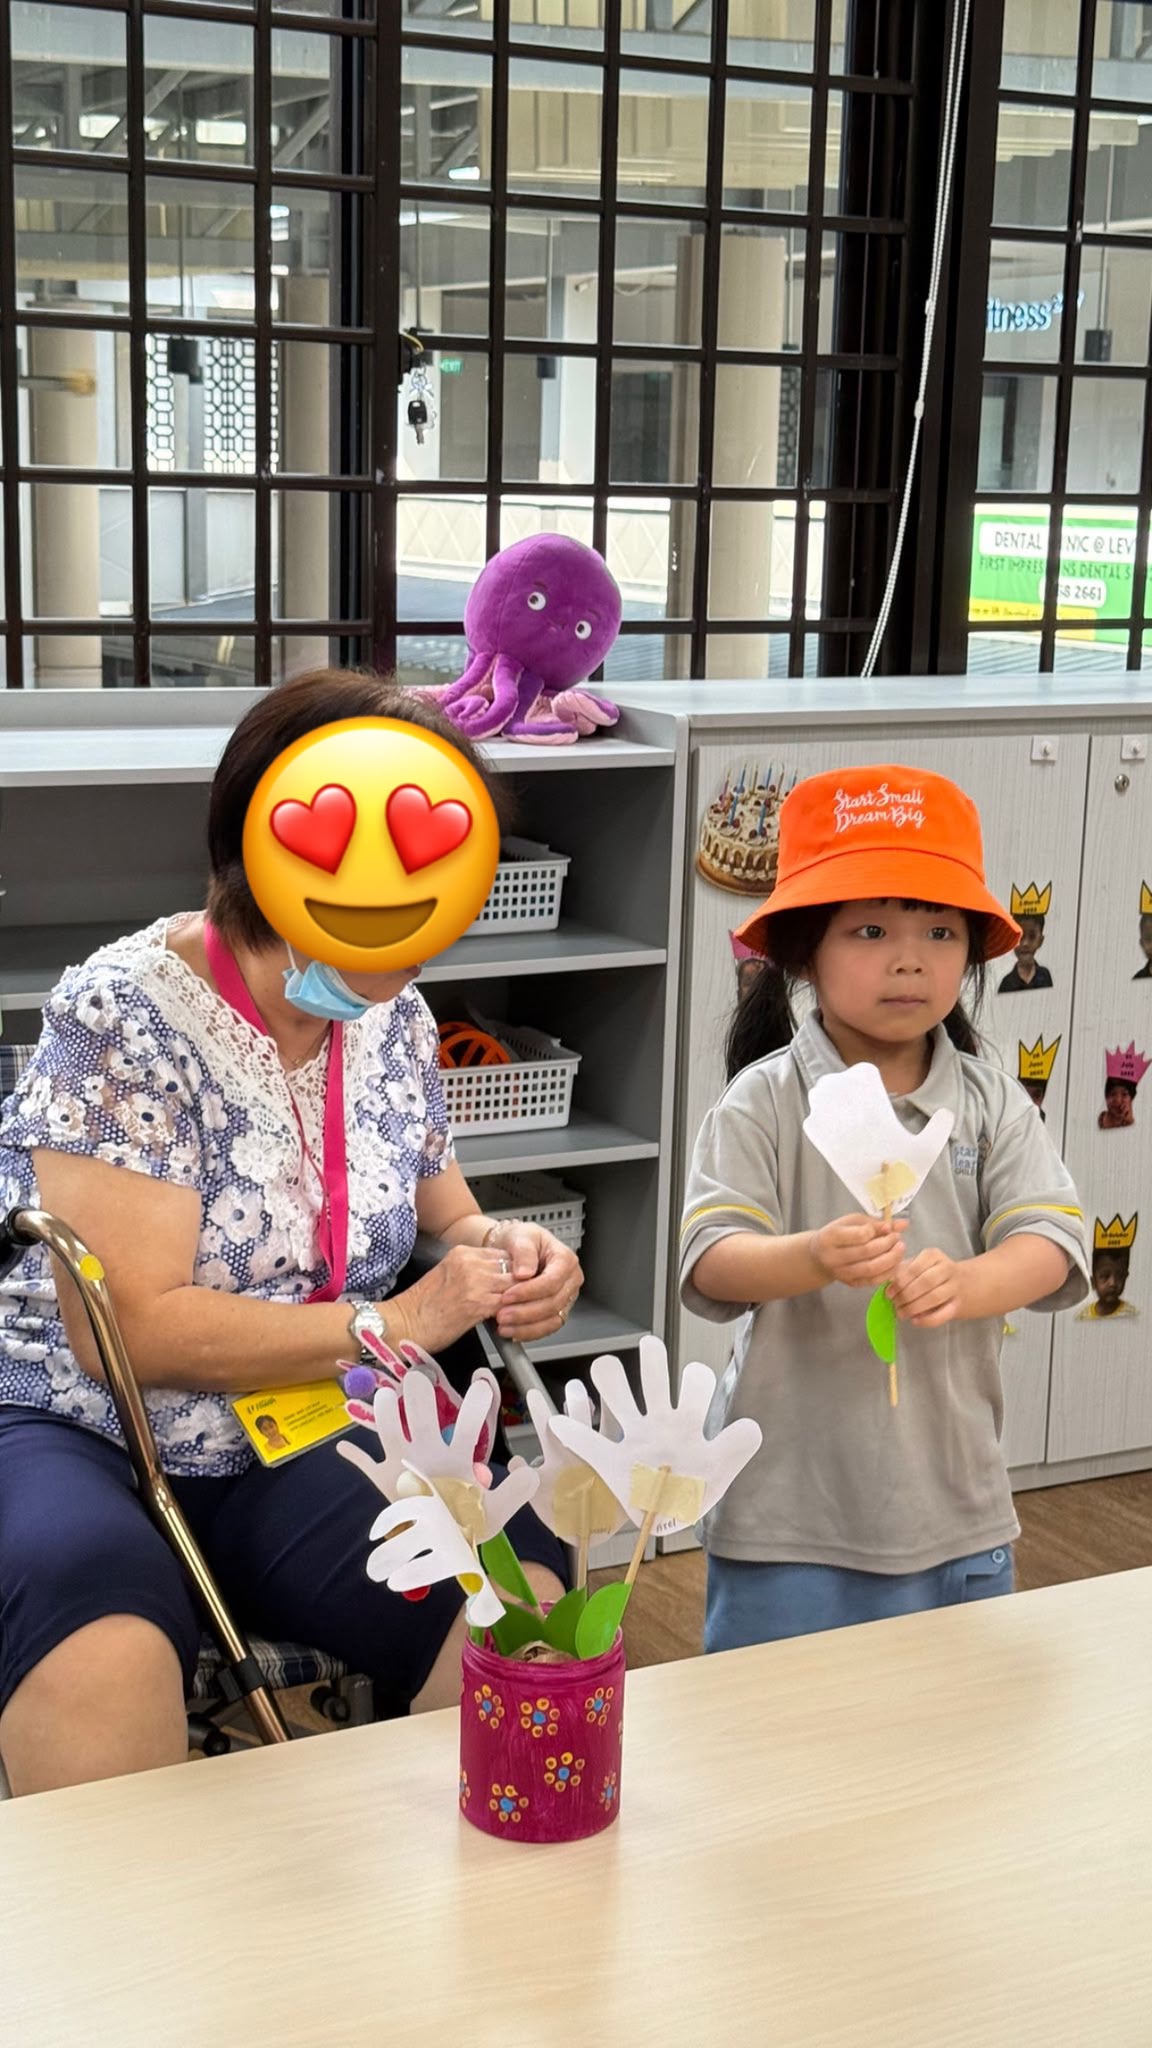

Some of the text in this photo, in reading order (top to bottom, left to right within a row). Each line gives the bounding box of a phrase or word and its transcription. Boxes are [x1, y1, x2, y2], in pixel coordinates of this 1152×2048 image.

[994, 531, 1042, 550] DENTAL
[1093, 536, 1105, 553] @
[1109, 537, 1135, 555] LEV
[979, 557, 1005, 571] FIRST
[1080, 563, 1120, 580] DENTAL
[1074, 585, 1102, 601] 2661
[833, 782, 925, 815] Start Small
[835, 805, 926, 833] Dream Big
